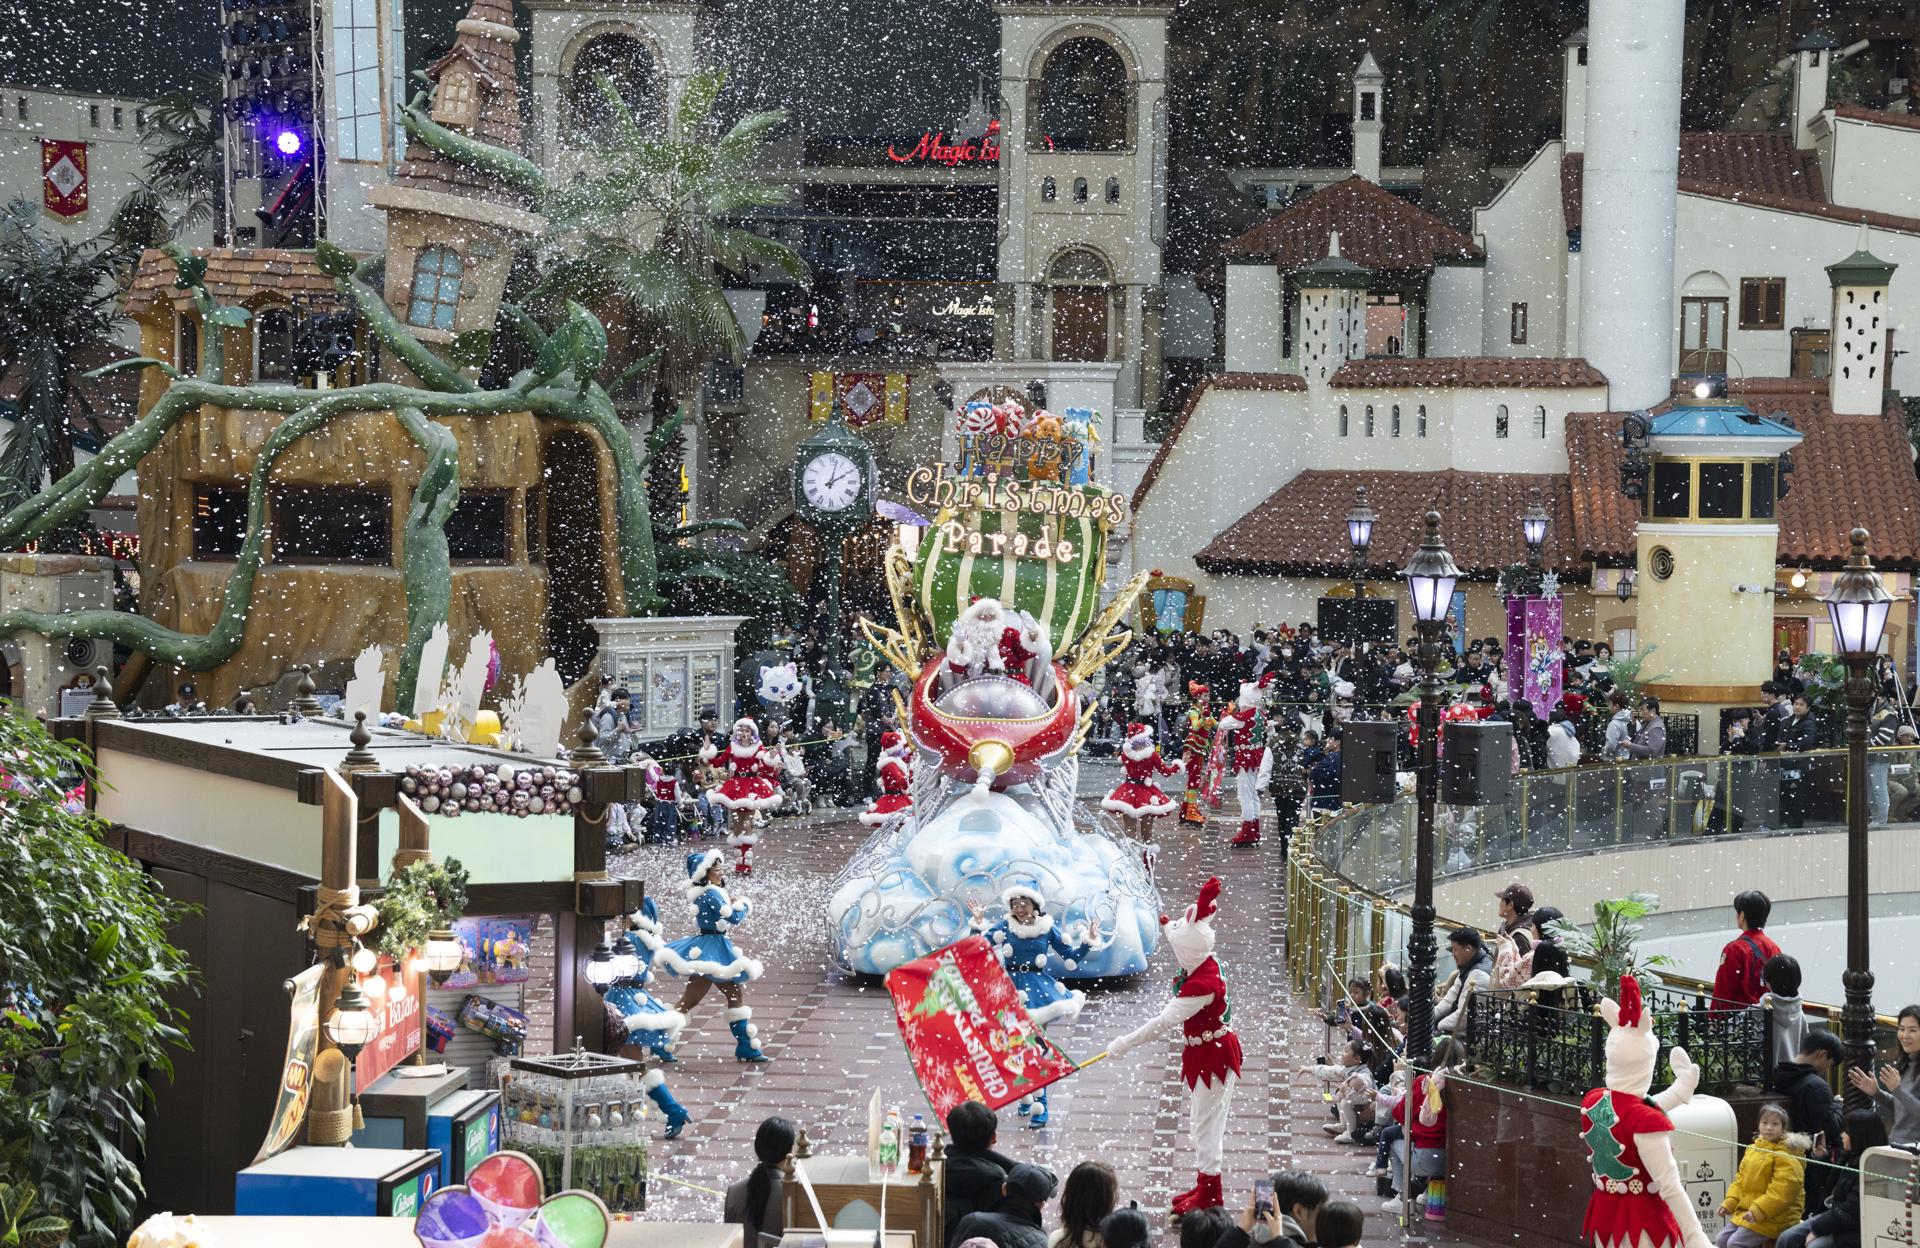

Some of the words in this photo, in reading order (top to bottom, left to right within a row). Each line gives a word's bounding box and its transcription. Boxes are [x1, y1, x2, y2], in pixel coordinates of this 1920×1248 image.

[887, 131, 977, 166] Magic
[932, 297, 978, 318] Magic
[978, 304, 995, 316] Isla
[954, 433, 1084, 470] Happy
[907, 462, 1125, 524] Christmas
[941, 519, 1073, 562] Parade
[937, 949, 989, 1029] PARADE
[928, 973, 1008, 1099] CHRISTMAS
[954, 1062, 987, 1104] APPY
